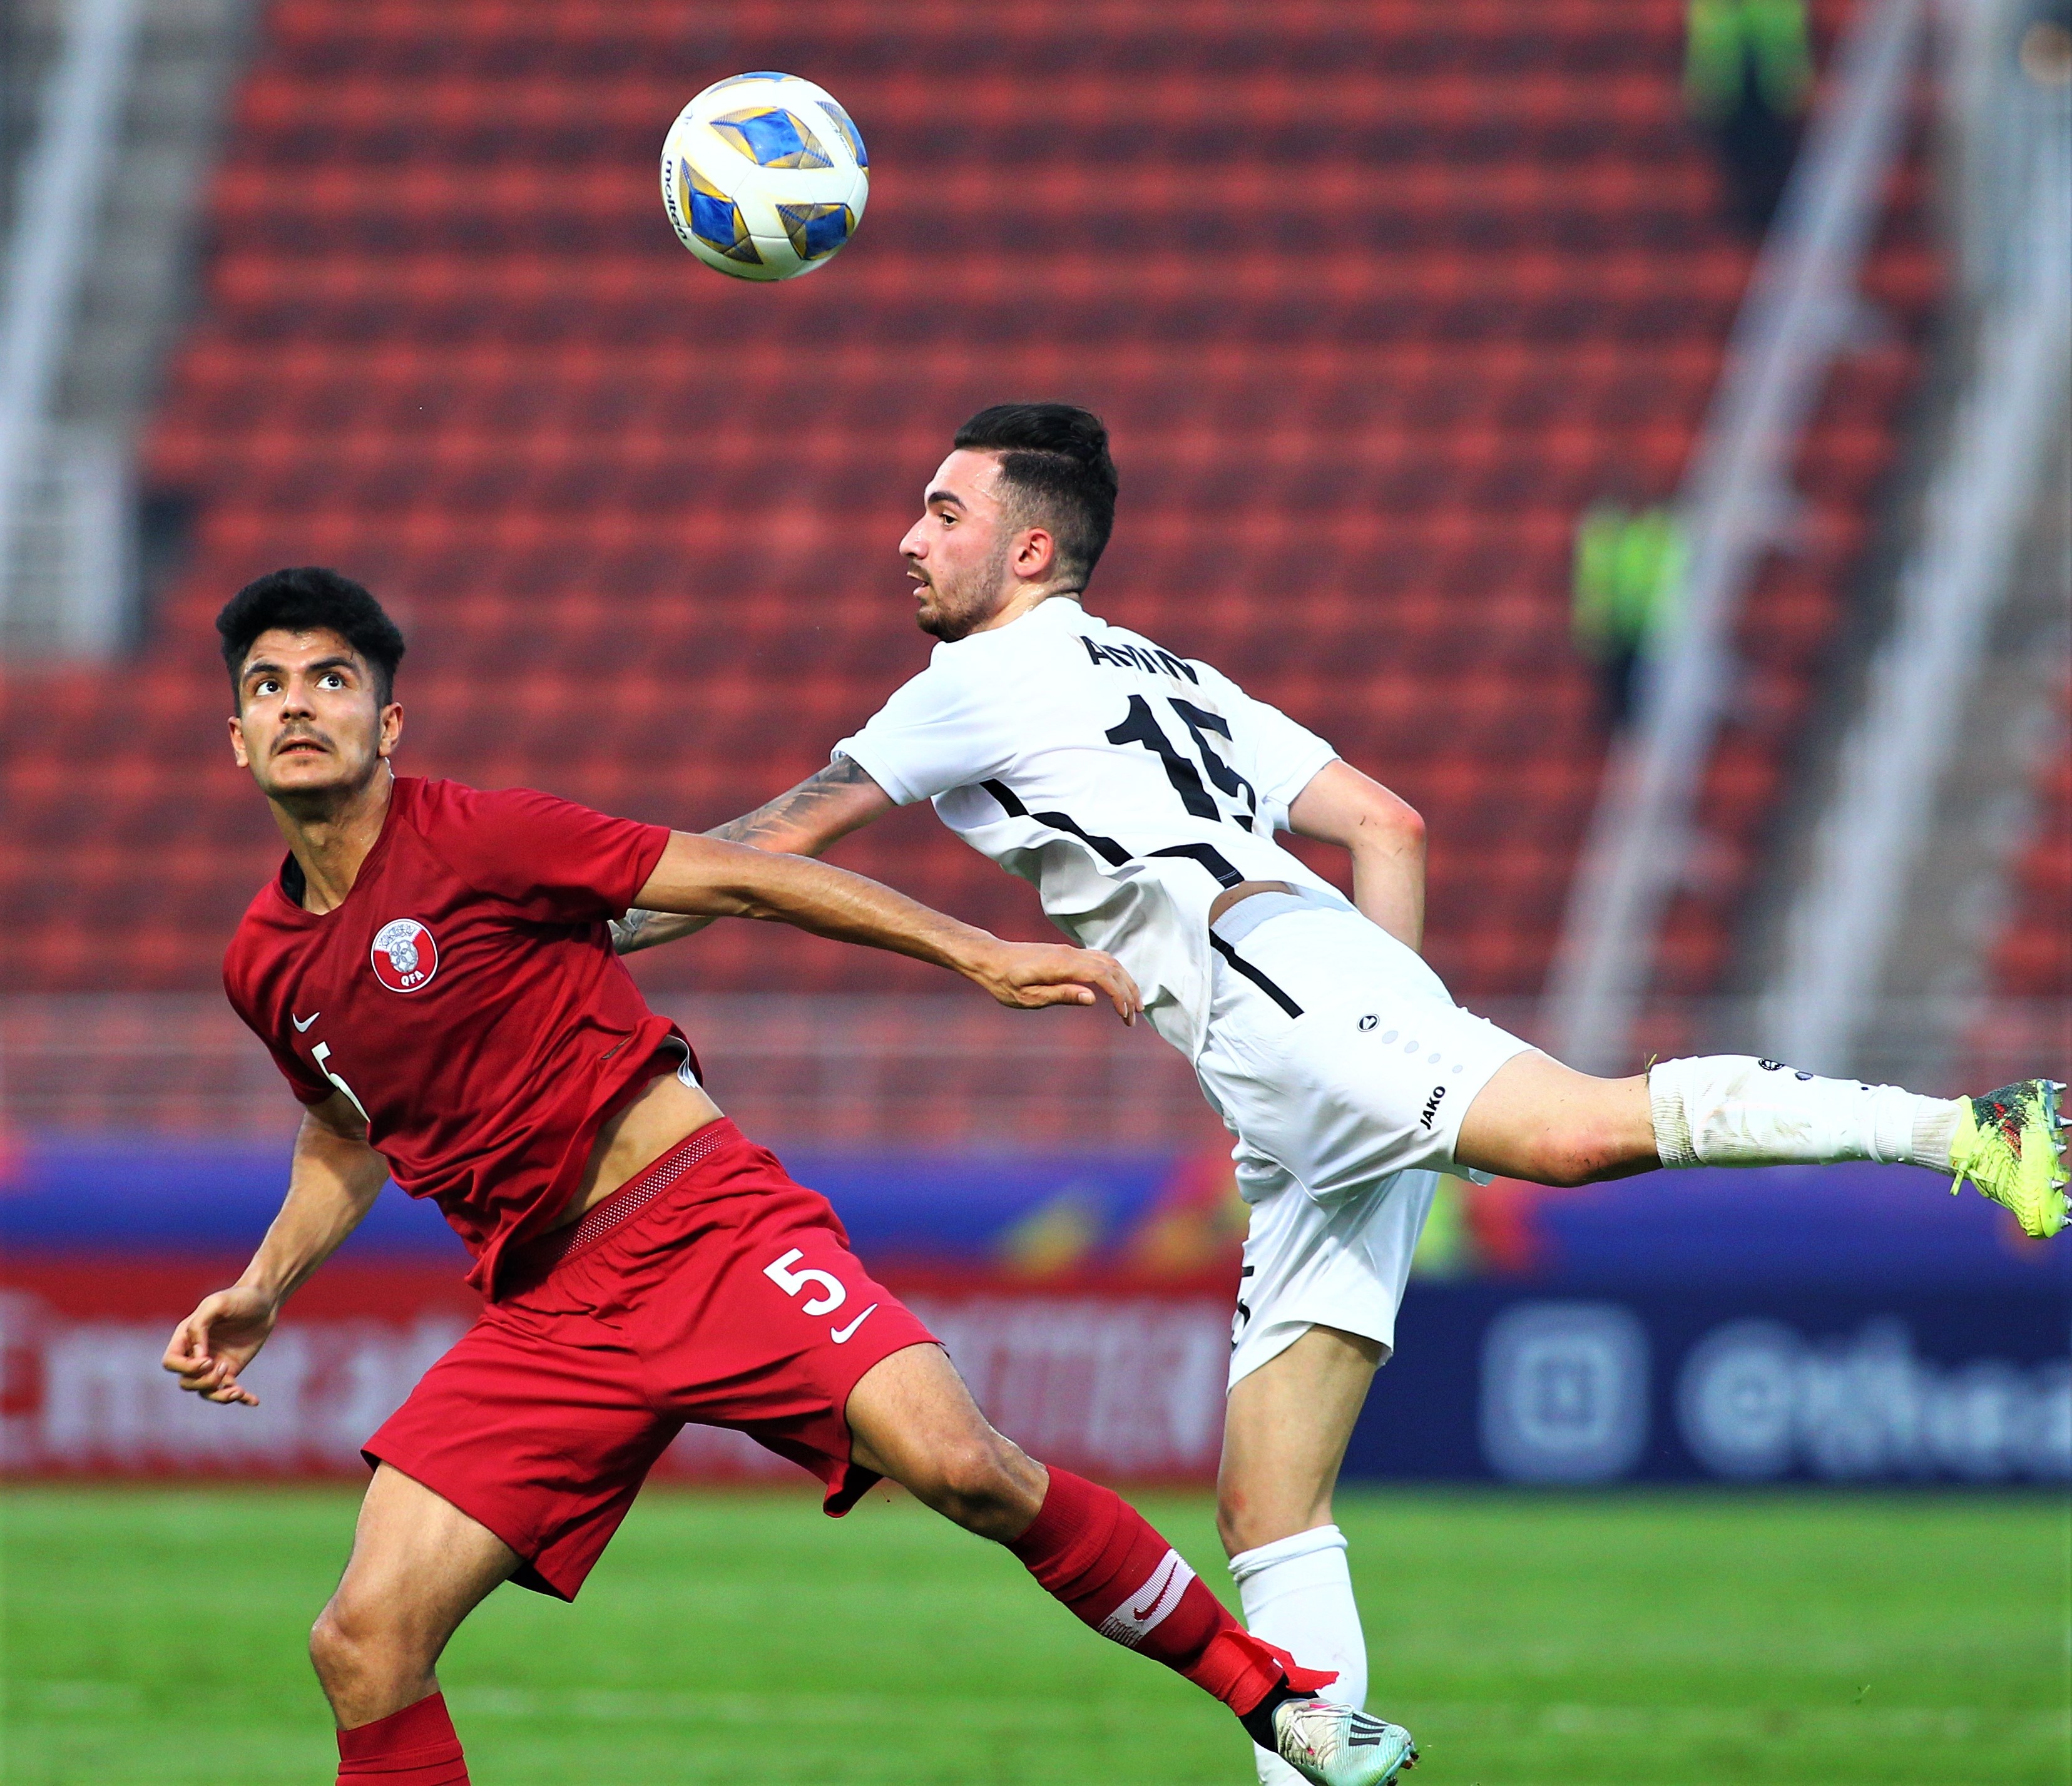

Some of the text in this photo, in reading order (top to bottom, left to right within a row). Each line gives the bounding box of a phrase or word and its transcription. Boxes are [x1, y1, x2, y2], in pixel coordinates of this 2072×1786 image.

[665, 160, 688, 239] molten
[1079, 635, 1200, 685] AMIN
[1105, 694, 1256, 834] 15
[401, 970, 425, 987] QFA
[1420, 1086, 1446, 1130] JAKO
[762, 1247, 847, 1317] 5
